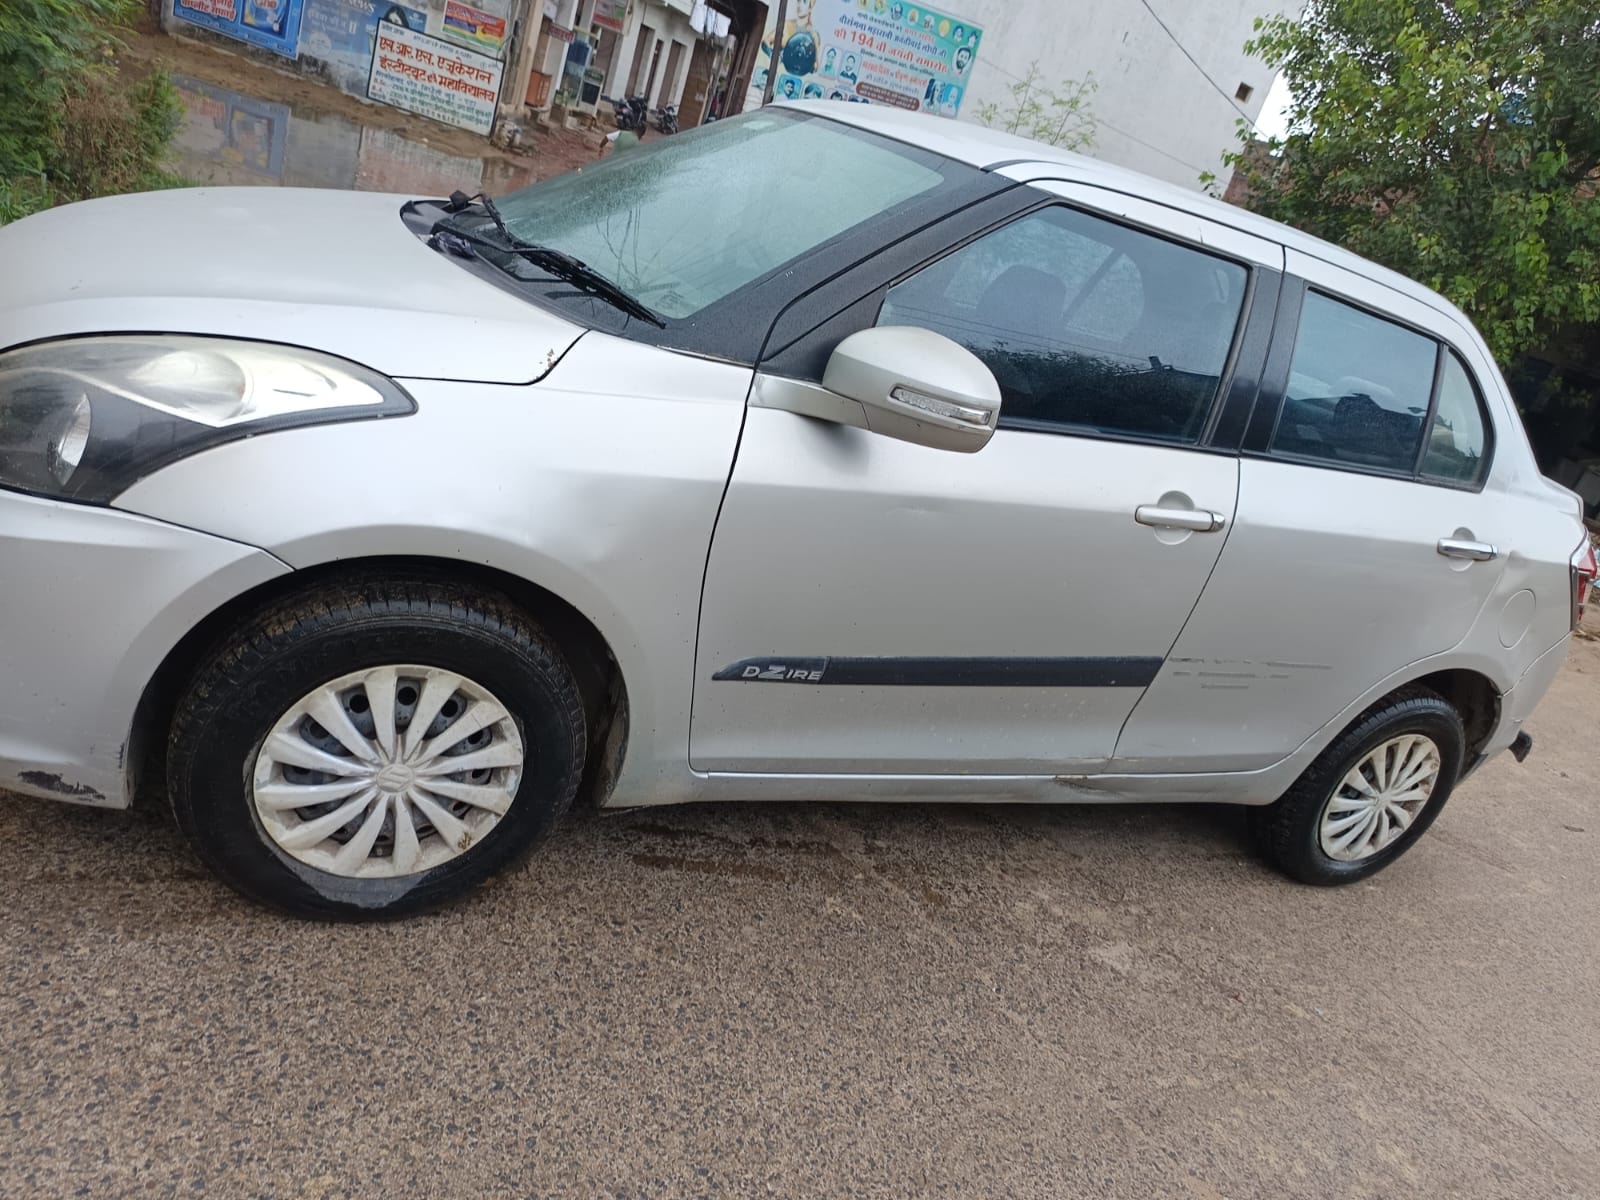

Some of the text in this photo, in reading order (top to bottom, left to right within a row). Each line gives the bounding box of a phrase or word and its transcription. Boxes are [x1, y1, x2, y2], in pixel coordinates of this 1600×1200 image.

[850, 31, 875, 49] 194
[437, 74, 496, 103] महाविद्यालय
[742, 665, 823, 680] DZIRE
